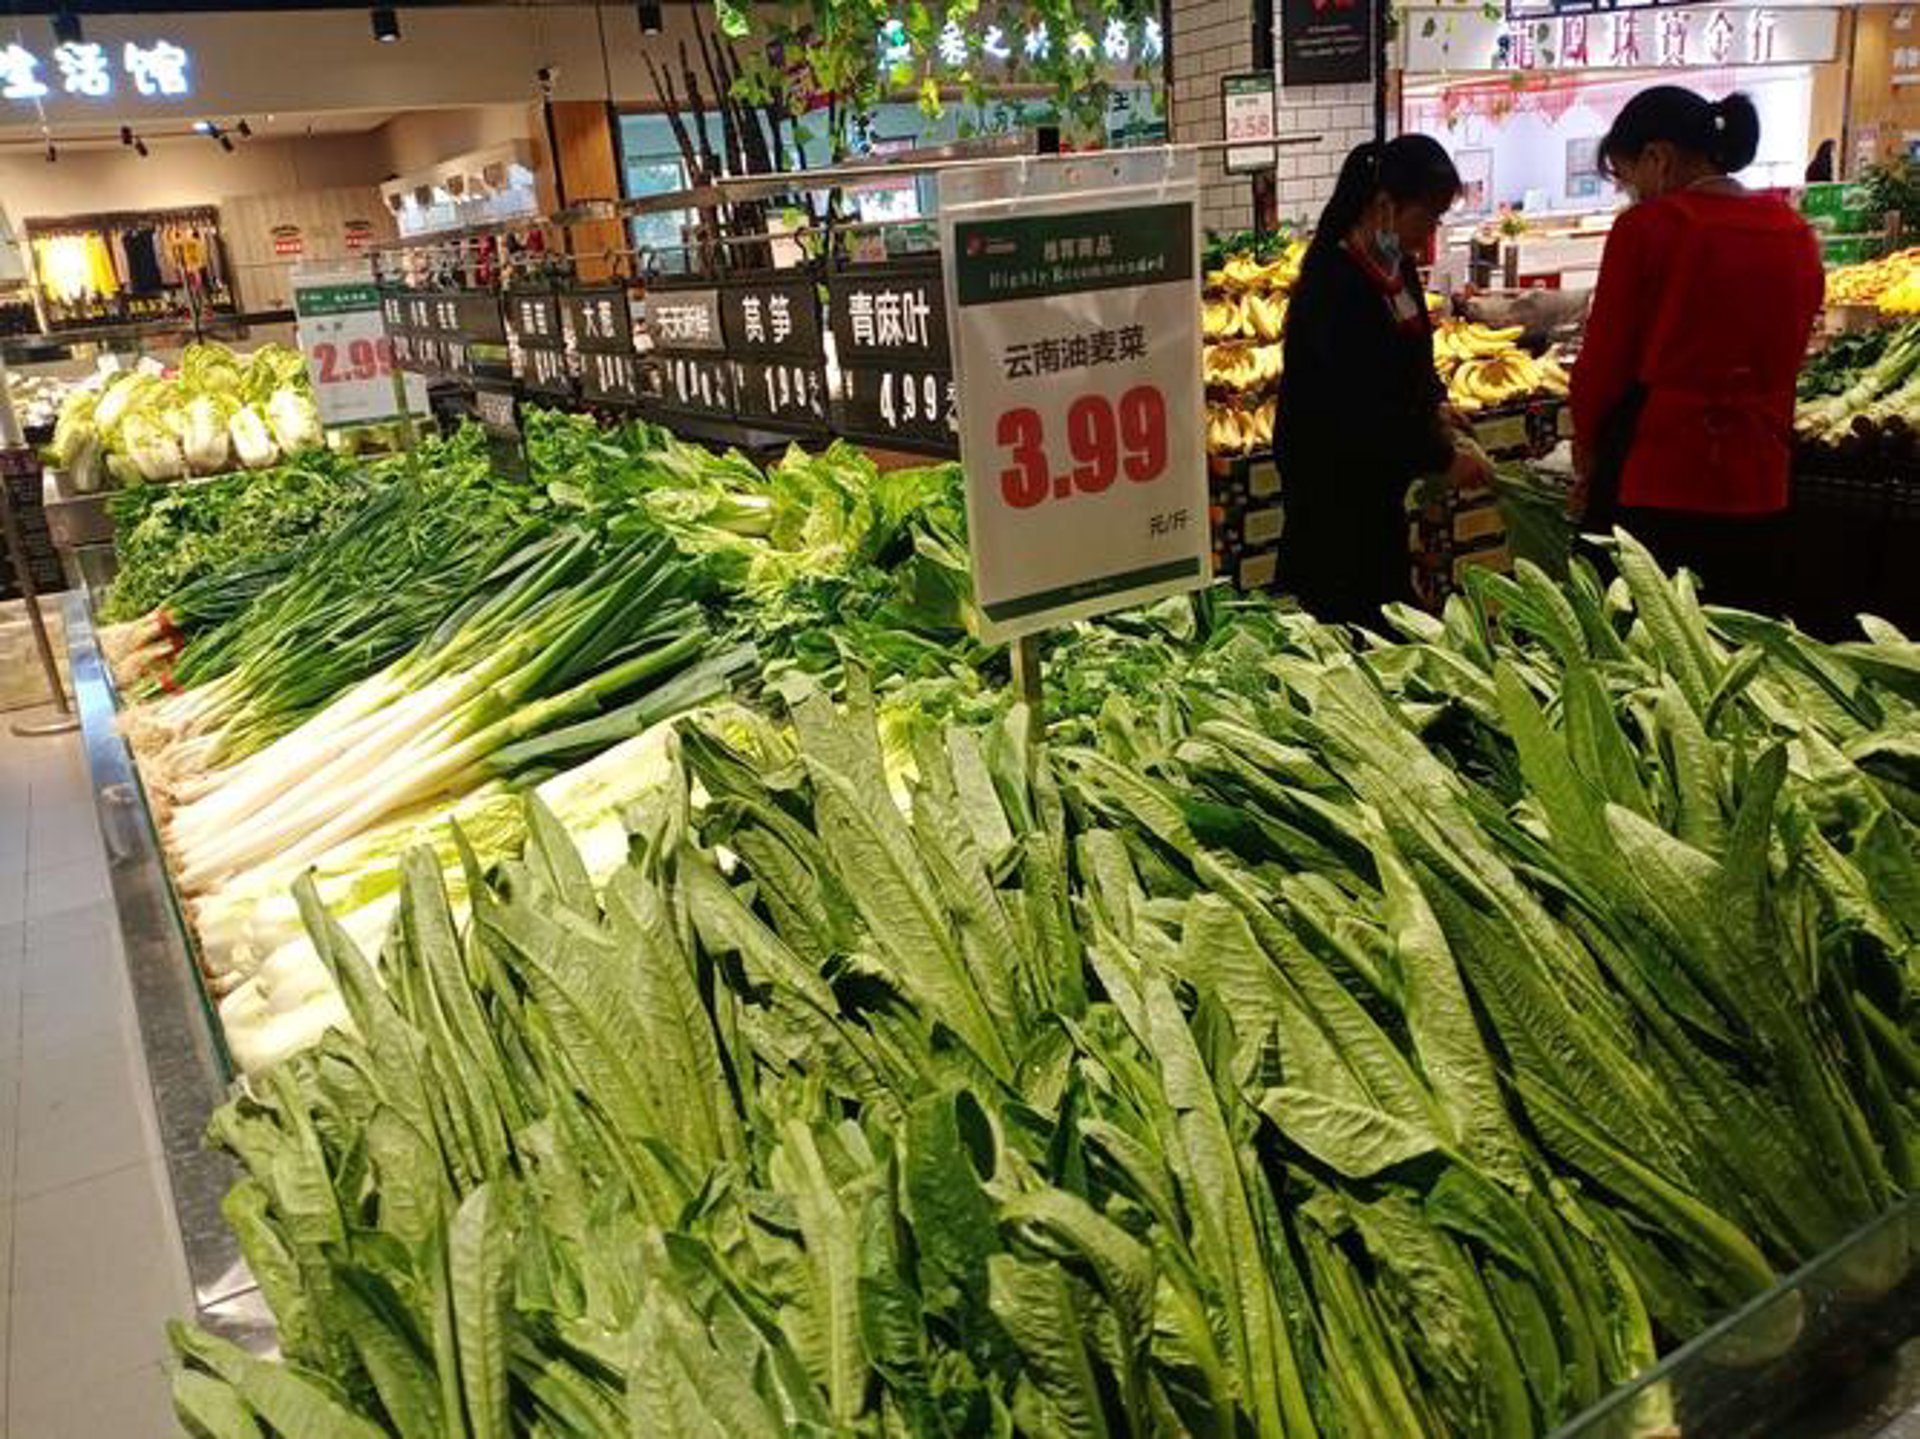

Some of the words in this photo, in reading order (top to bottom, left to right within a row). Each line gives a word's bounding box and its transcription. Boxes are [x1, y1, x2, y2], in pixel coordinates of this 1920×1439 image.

[849, 288, 931, 347] 青麻叶
[1003, 324, 1148, 379] 云南油麦菜
[995, 385, 1168, 510] 3.99
